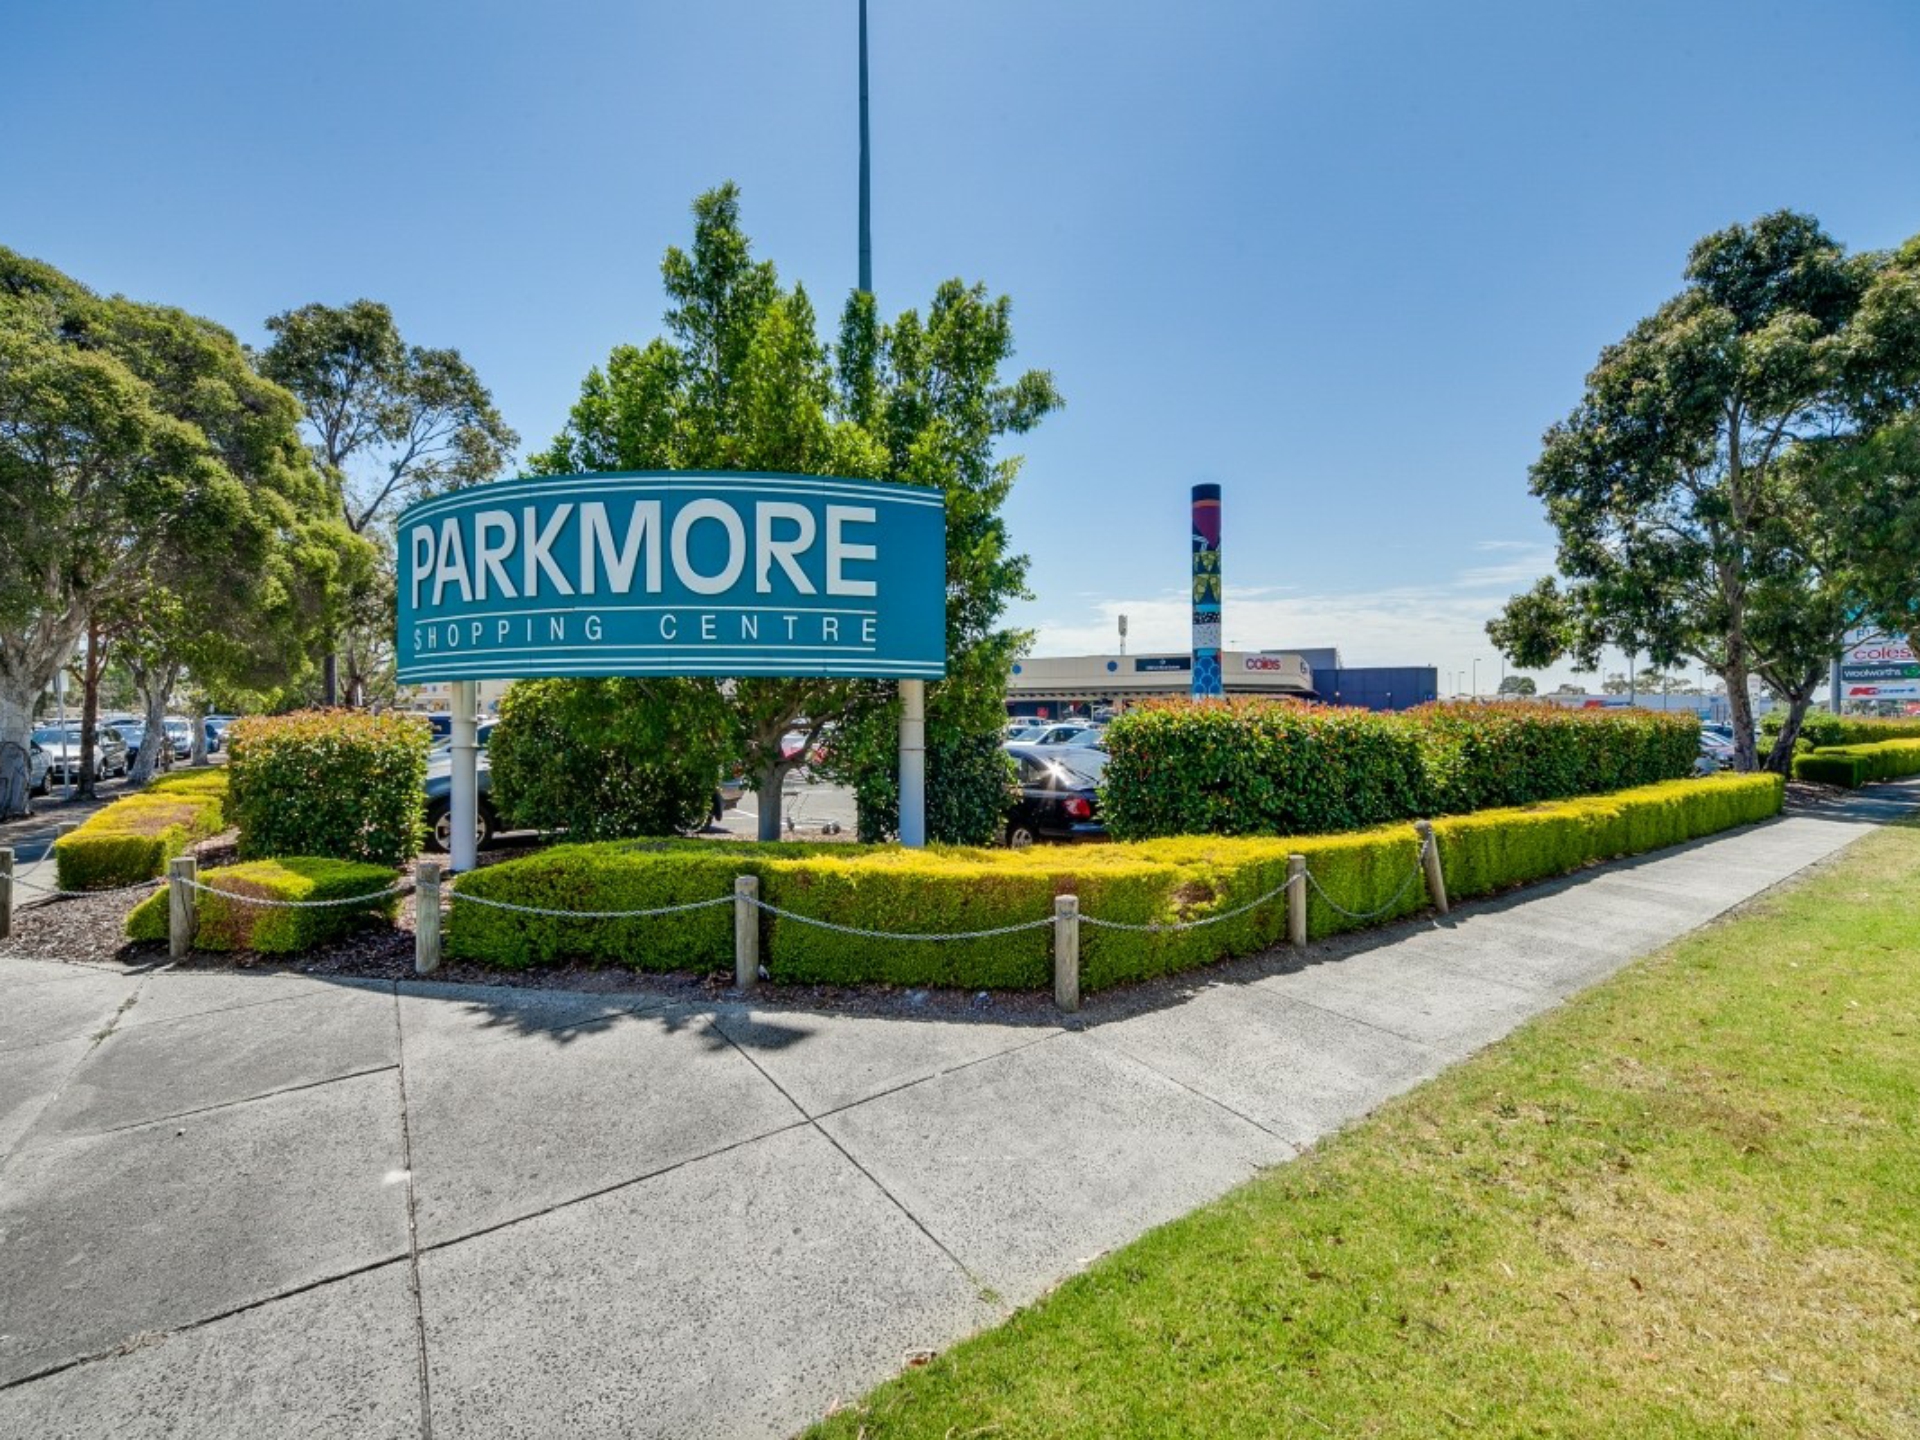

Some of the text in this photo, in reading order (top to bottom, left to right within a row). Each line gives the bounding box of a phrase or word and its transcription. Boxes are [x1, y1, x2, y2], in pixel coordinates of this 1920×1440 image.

[411, 498, 878, 609] PARKMORE
[414, 613, 878, 651] SHOPPING CENTRE
[1853, 647, 1912, 660] coles
